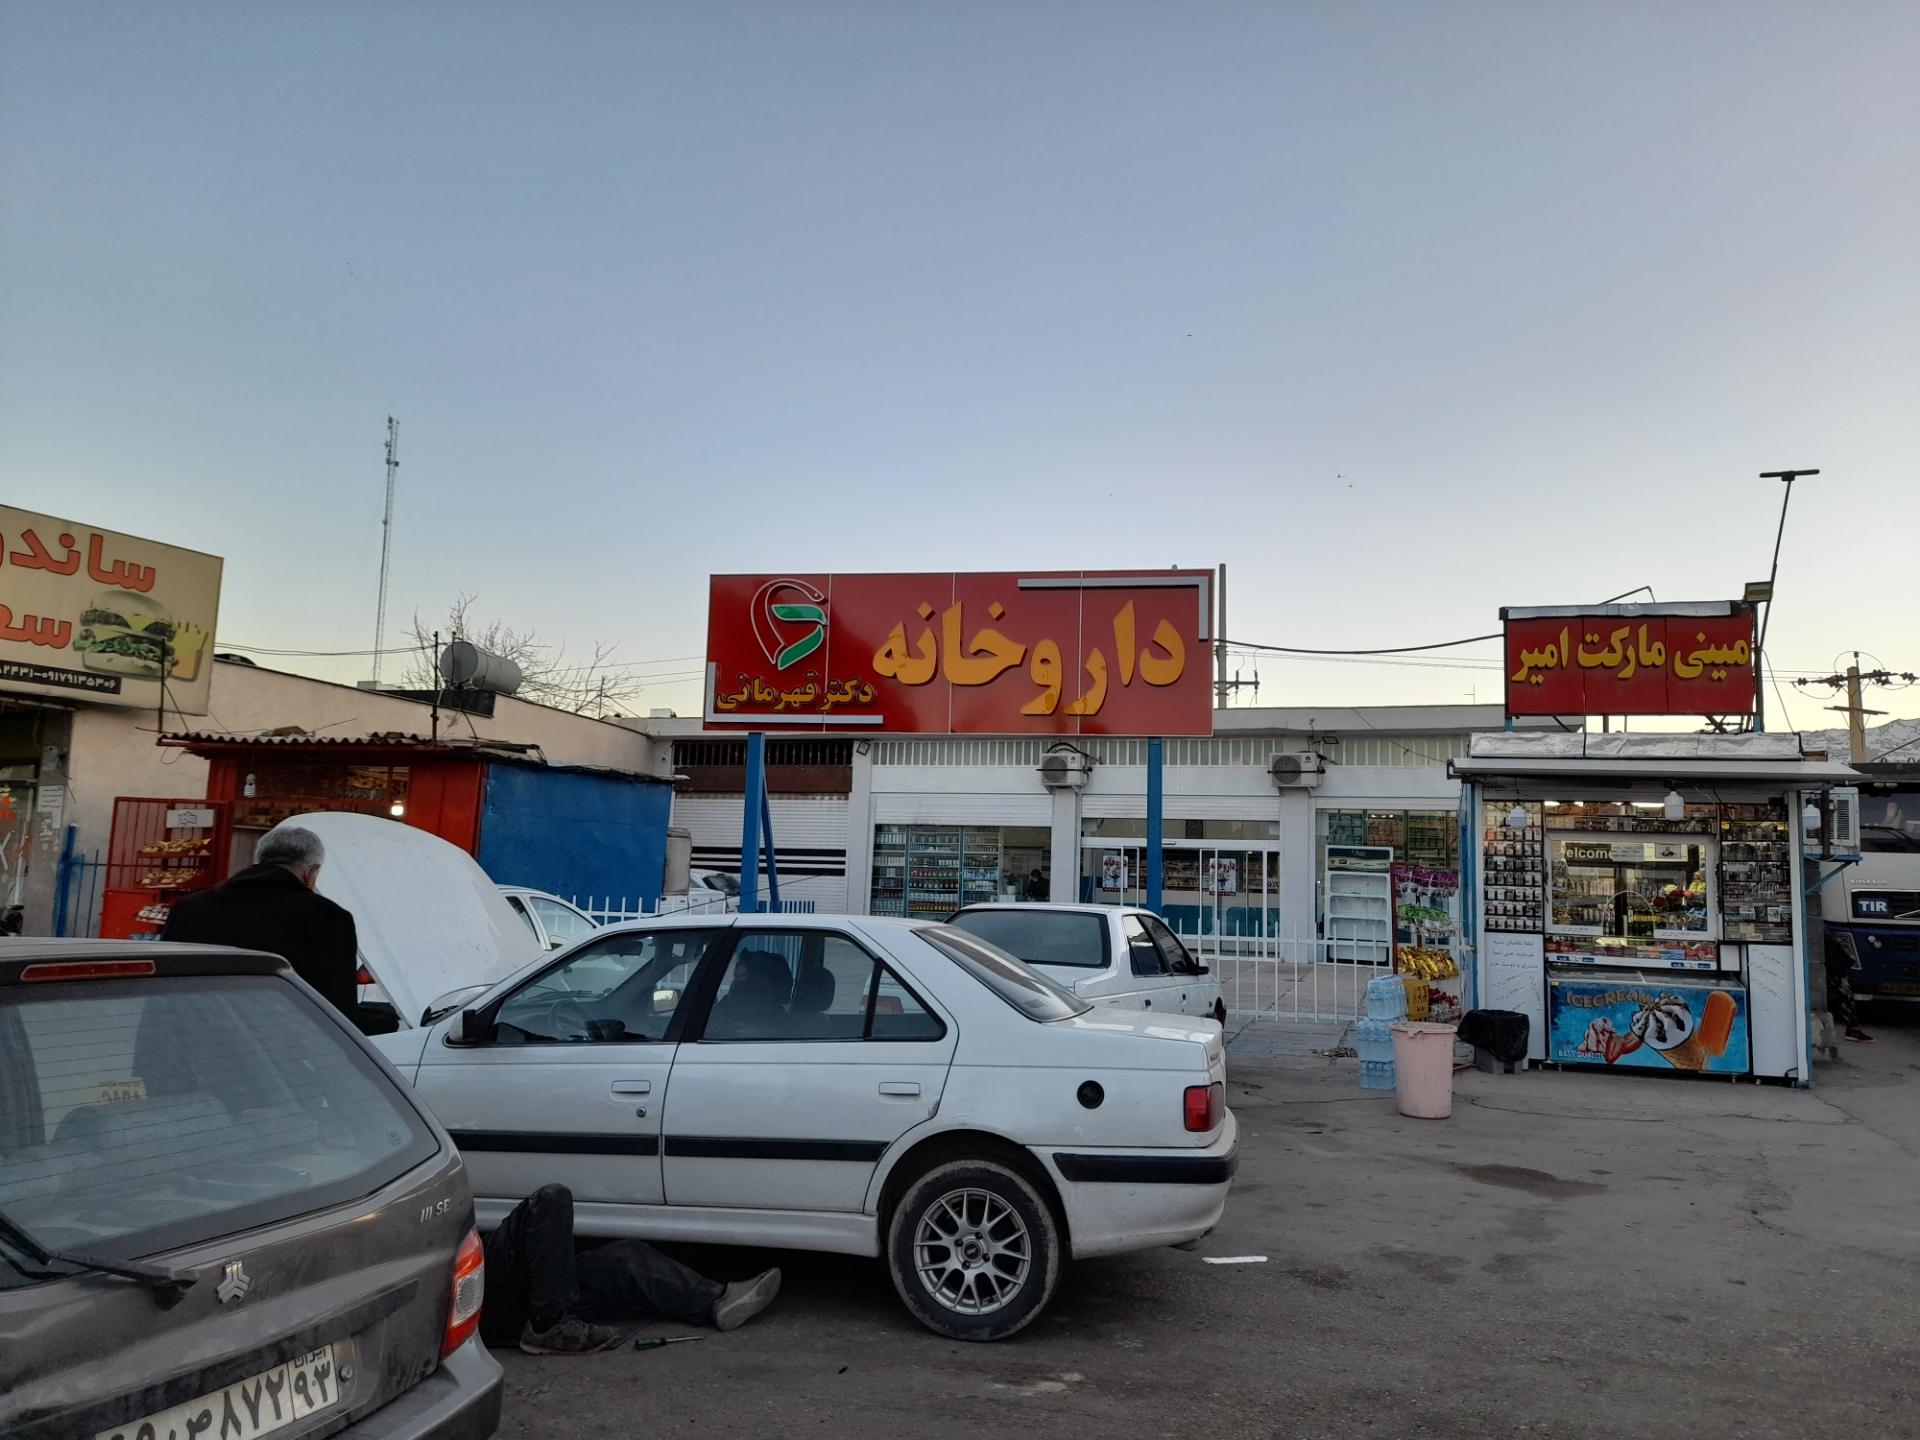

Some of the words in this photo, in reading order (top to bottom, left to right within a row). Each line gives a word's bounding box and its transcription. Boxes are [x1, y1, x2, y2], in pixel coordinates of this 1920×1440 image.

[0, 529, 156, 592] ساند
[872, 599, 1186, 716] داروخانه
[1511, 625, 1569, 684] امیر
[1577, 622, 1666, 680] مارکت
[1674, 631, 1749, 680] مینی
[716, 671, 818, 711] قهرمانی
[819, 678, 875, 711] دکتر
[1566, 847, 1612, 859] elcom
[1858, 900, 1888, 912] TIR
[436, 1198, 450, 1216] SE
[294, 1347, 326, 1369] ایران
